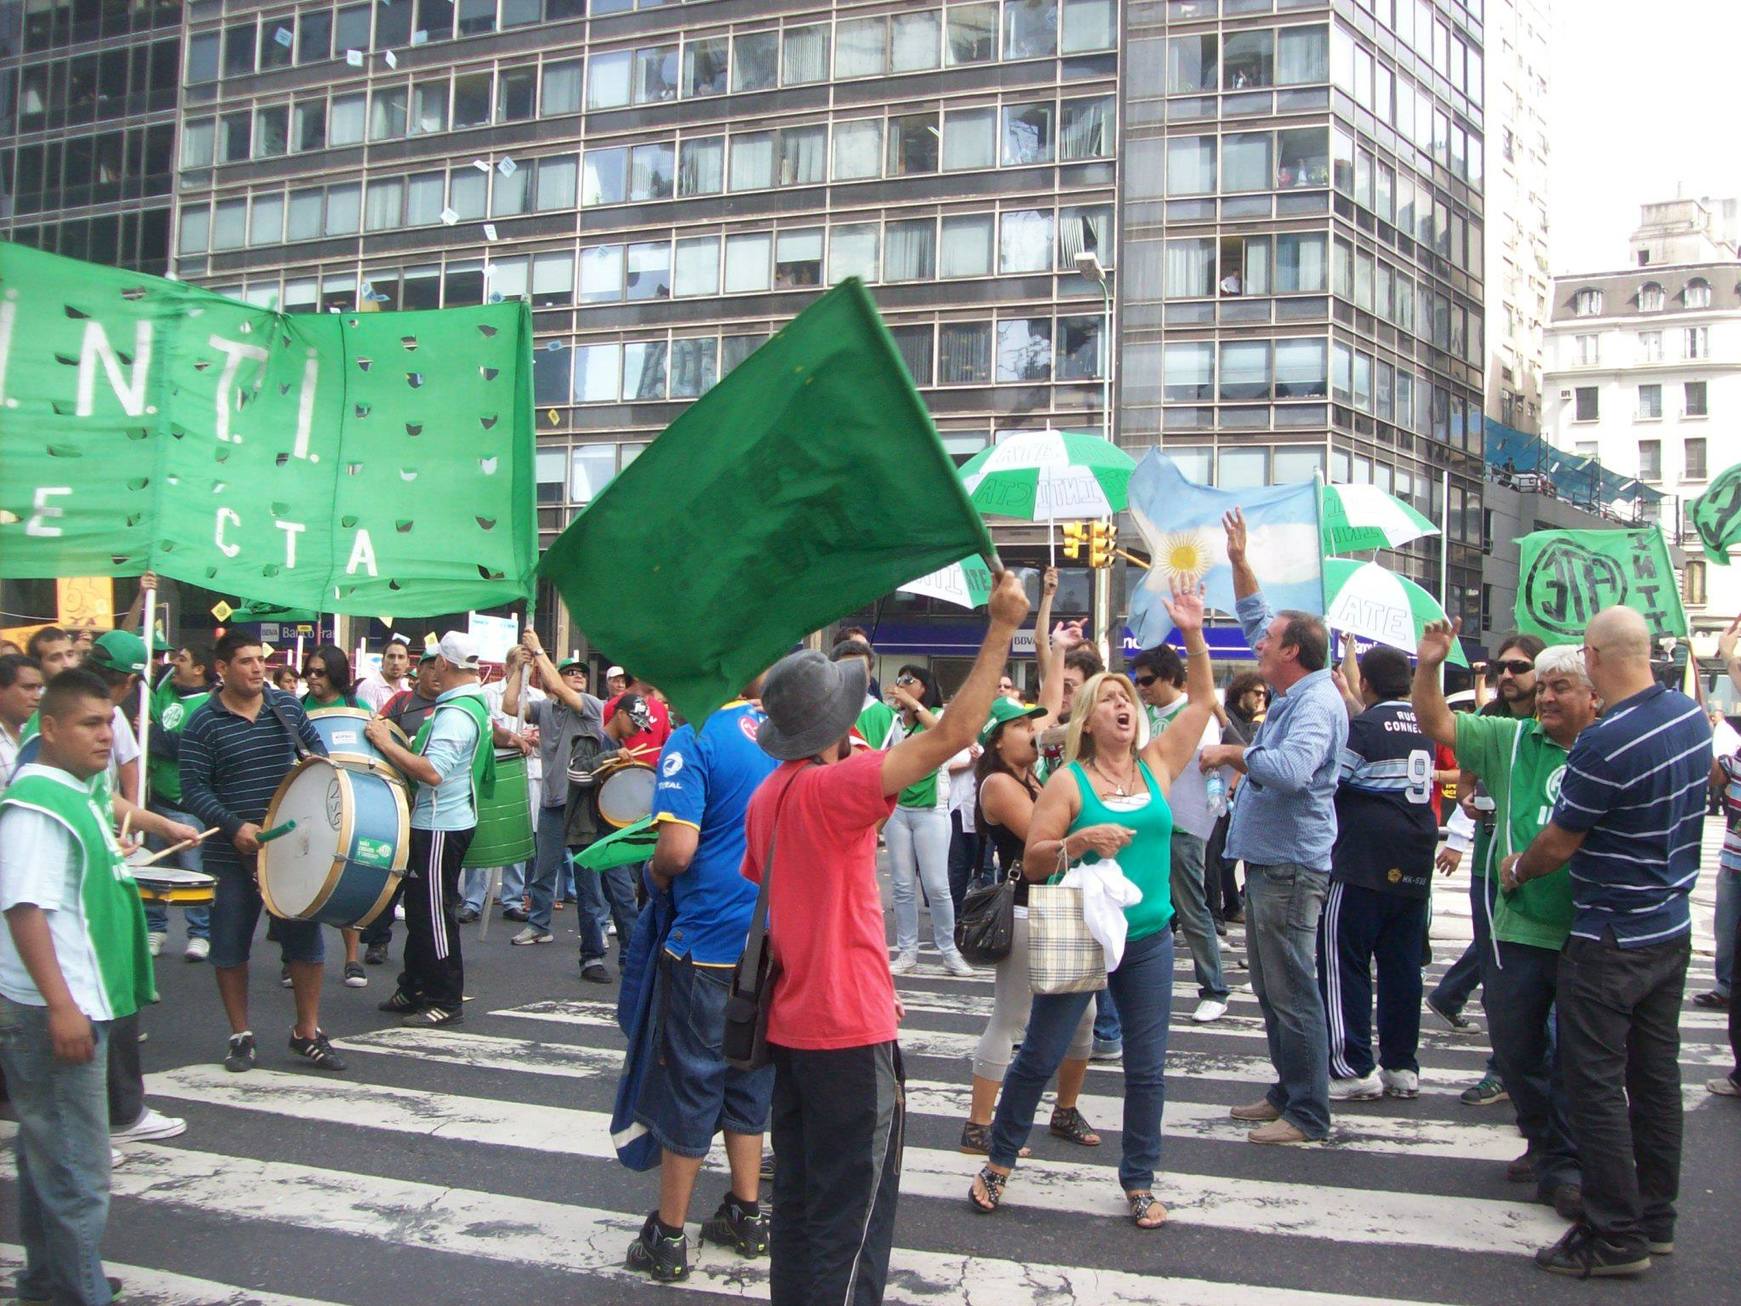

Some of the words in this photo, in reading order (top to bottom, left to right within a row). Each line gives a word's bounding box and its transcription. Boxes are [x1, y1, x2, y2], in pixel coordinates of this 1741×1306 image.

[1338, 594, 1408, 641] ATE
[1383, 720, 1422, 734] CONNE
[1405, 749, 1432, 804] 9
